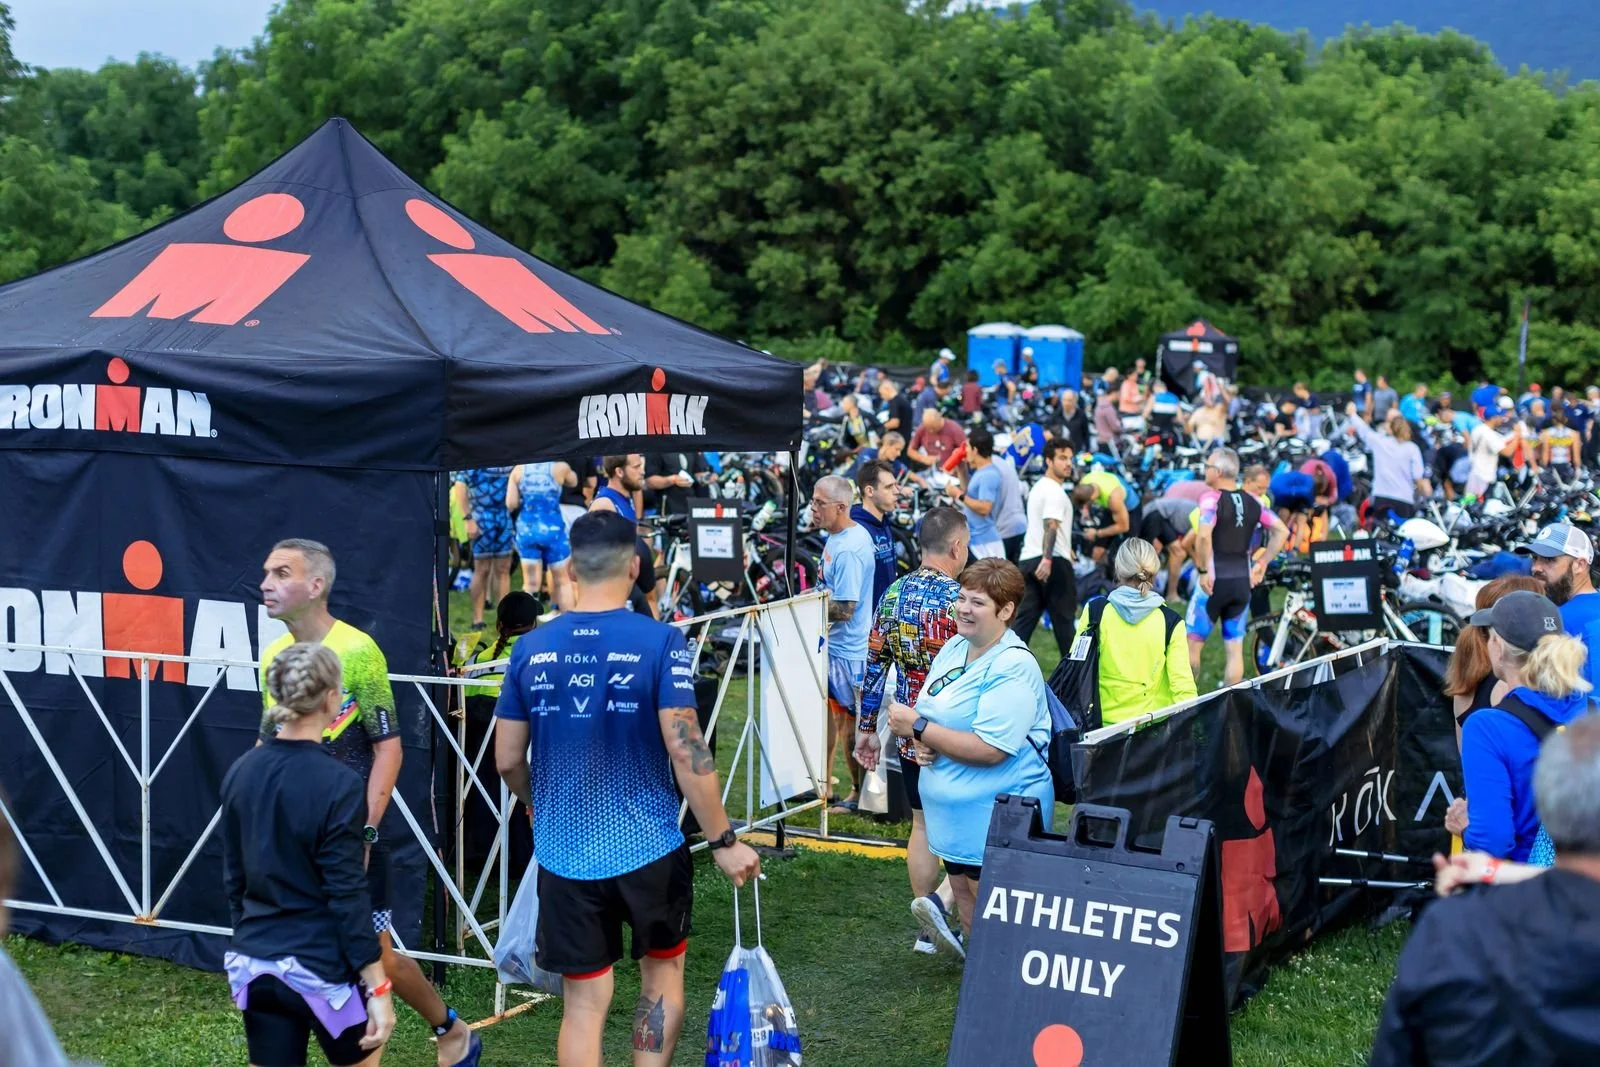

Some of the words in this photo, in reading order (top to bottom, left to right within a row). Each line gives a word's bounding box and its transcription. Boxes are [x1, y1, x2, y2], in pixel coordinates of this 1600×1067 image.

[578, 392, 709, 439] IRONMAN
[529, 652, 558, 666] HOKA
[606, 652, 641, 663] Santini
[568, 674, 594, 687] AG1
[982, 886, 1182, 949] ATHLETES
[1021, 950, 1126, 998] ONLY
